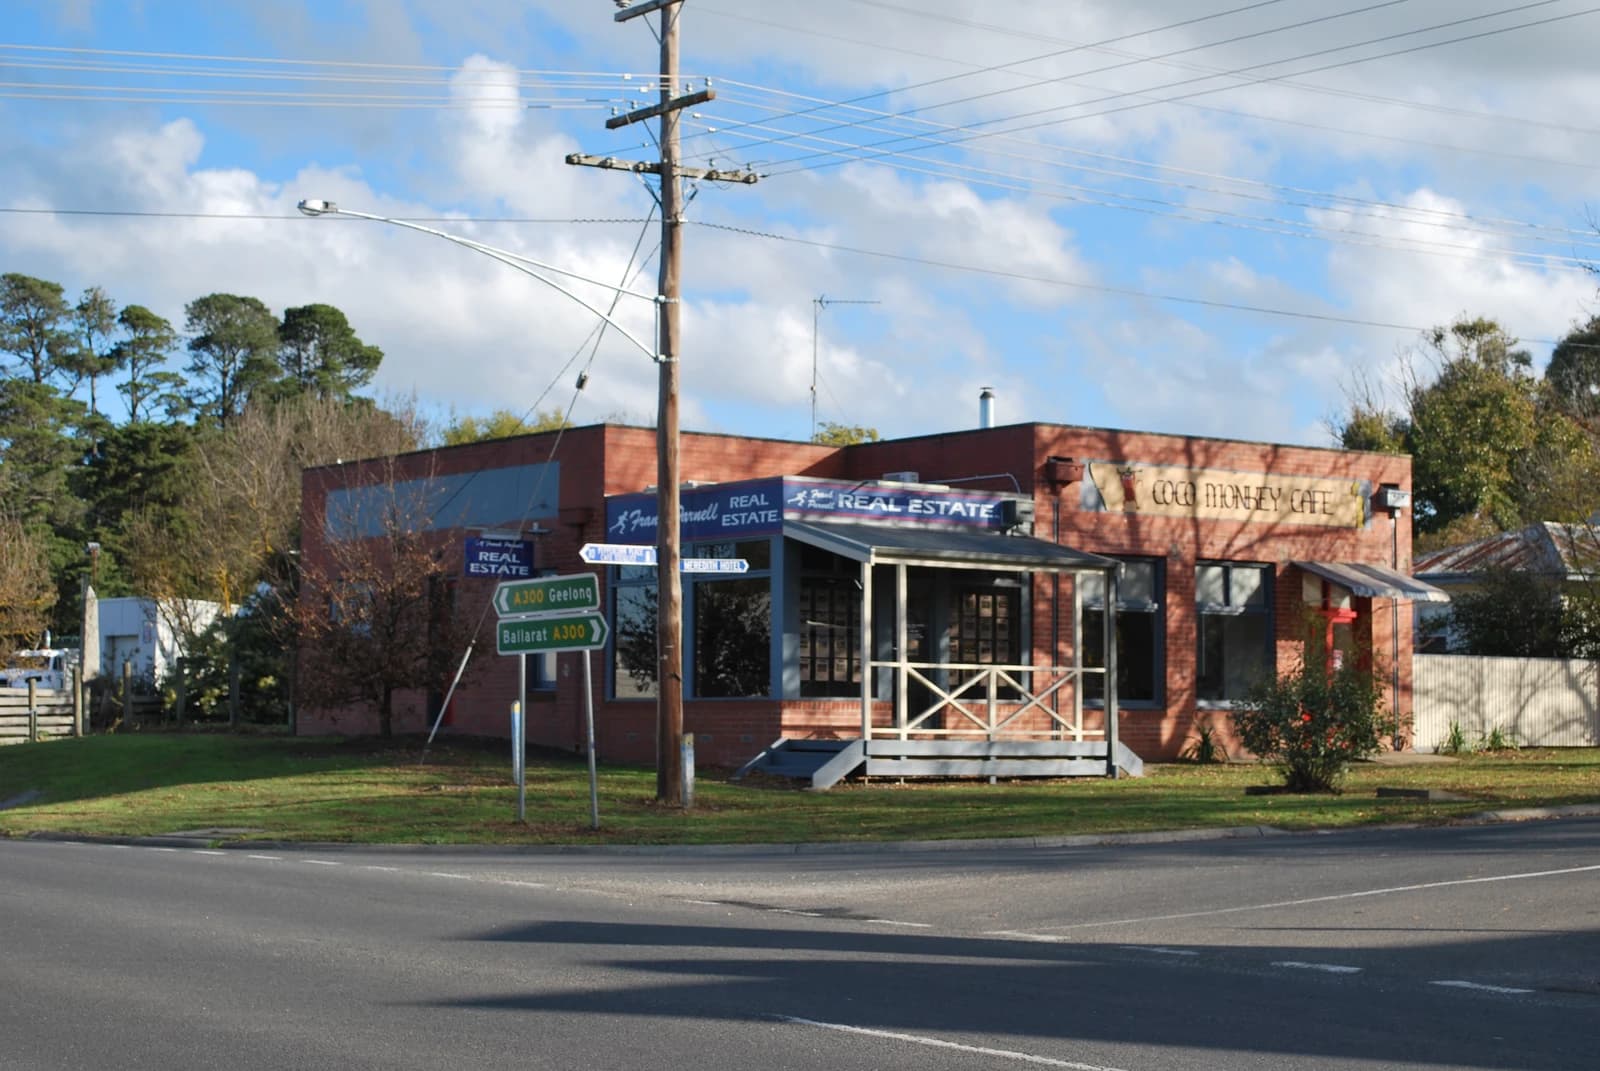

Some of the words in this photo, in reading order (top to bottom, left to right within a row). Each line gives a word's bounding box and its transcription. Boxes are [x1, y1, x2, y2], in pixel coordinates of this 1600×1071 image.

[730, 493, 769, 508] REAL
[838, 493, 901, 513] REAL
[1152, 479, 1197, 507] COCO
[1205, 482, 1282, 512] MONKEY
[1290, 488, 1335, 516] CAFE
[629, 509, 658, 532] Fran
[478, 551, 521, 563] REAL
[469, 562, 529, 576] ESTATE
[514, 588, 544, 606] A300
[548, 587, 593, 603] Geelong
[503, 627, 548, 644] Ballarat
[552, 624, 585, 640] A300
